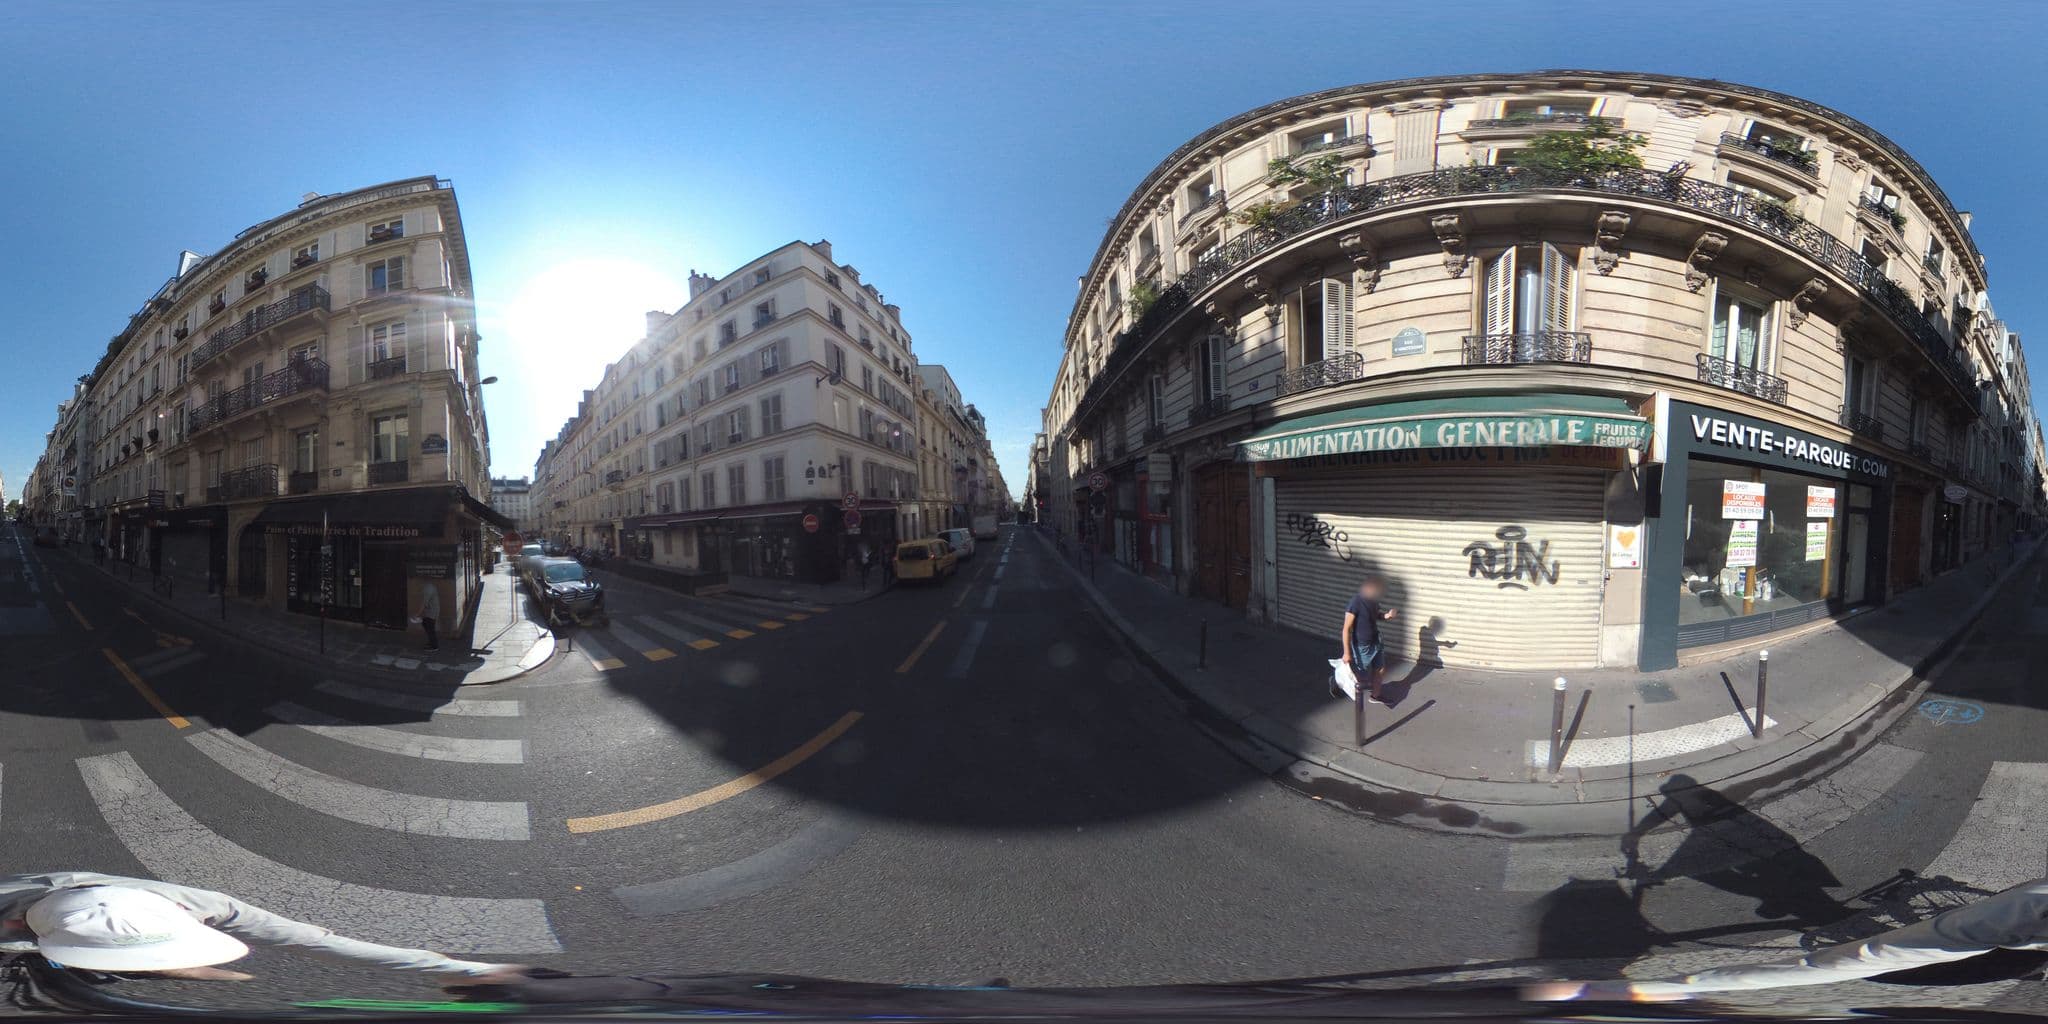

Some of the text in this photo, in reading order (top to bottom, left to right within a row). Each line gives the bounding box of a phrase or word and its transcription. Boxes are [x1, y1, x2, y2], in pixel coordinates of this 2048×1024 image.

[1271, 419, 1585, 459] ALIMENTATION GENERALE
[1594, 423, 1637, 437] FRUITS
[1691, 414, 1888, 480] VENTE-PARQUET.COM
[362, 526, 419, 537] Tradition
